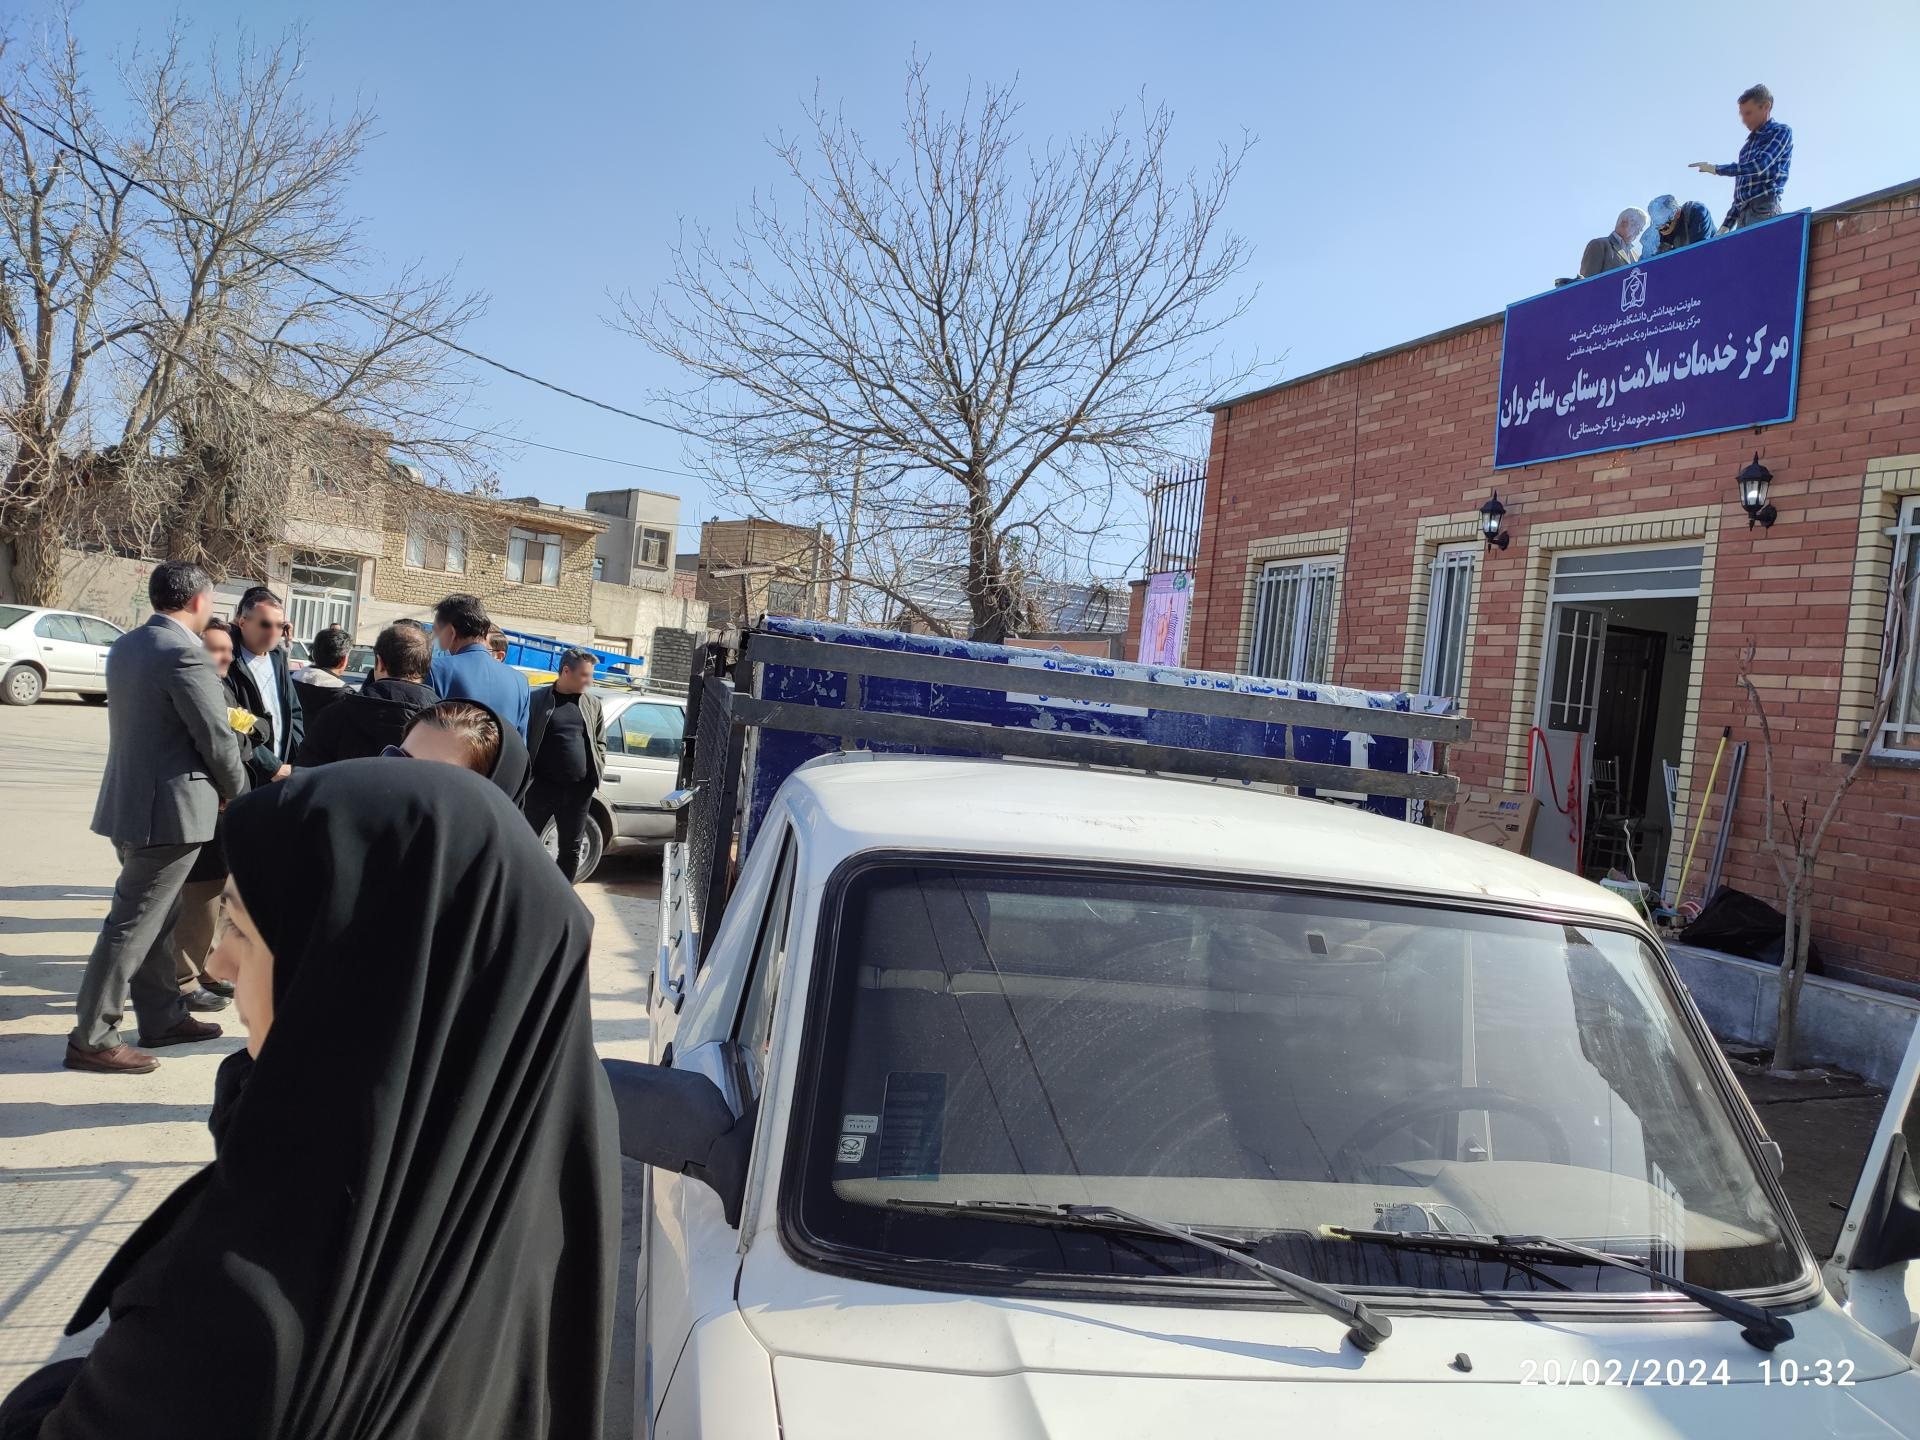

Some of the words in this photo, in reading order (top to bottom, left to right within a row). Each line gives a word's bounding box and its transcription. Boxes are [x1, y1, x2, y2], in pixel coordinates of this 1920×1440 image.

[1676, 297, 1701, 313] معاونت
[1622, 311, 1647, 326] دانشگاه
[1647, 305, 1677, 322] بهداشتی
[1607, 318, 1623, 333] علوم
[1658, 320, 1687, 333] بهداشت
[1685, 315, 1701, 329] مرکز
[1569, 329, 1587, 342] مشهد
[1586, 323, 1609, 339] پزشکی
[1630, 330, 1641, 342] یک
[1641, 326, 1659, 341] شماره
[1585, 342, 1602, 354] مشهد
[1601, 334, 1631, 351] شهرستان
[1566, 346, 1585, 360] مقدس
[1674, 332, 1738, 380] خدمات
[1739, 324, 1789, 380] مرکز
[1618, 347, 1671, 393] سلامت
[1556, 367, 1616, 416] روستایی
[1500, 377, 1555, 428] ساغروان
[1610, 413, 1626, 432] ثریا
[1625, 414, 1656, 429] مرحومه
